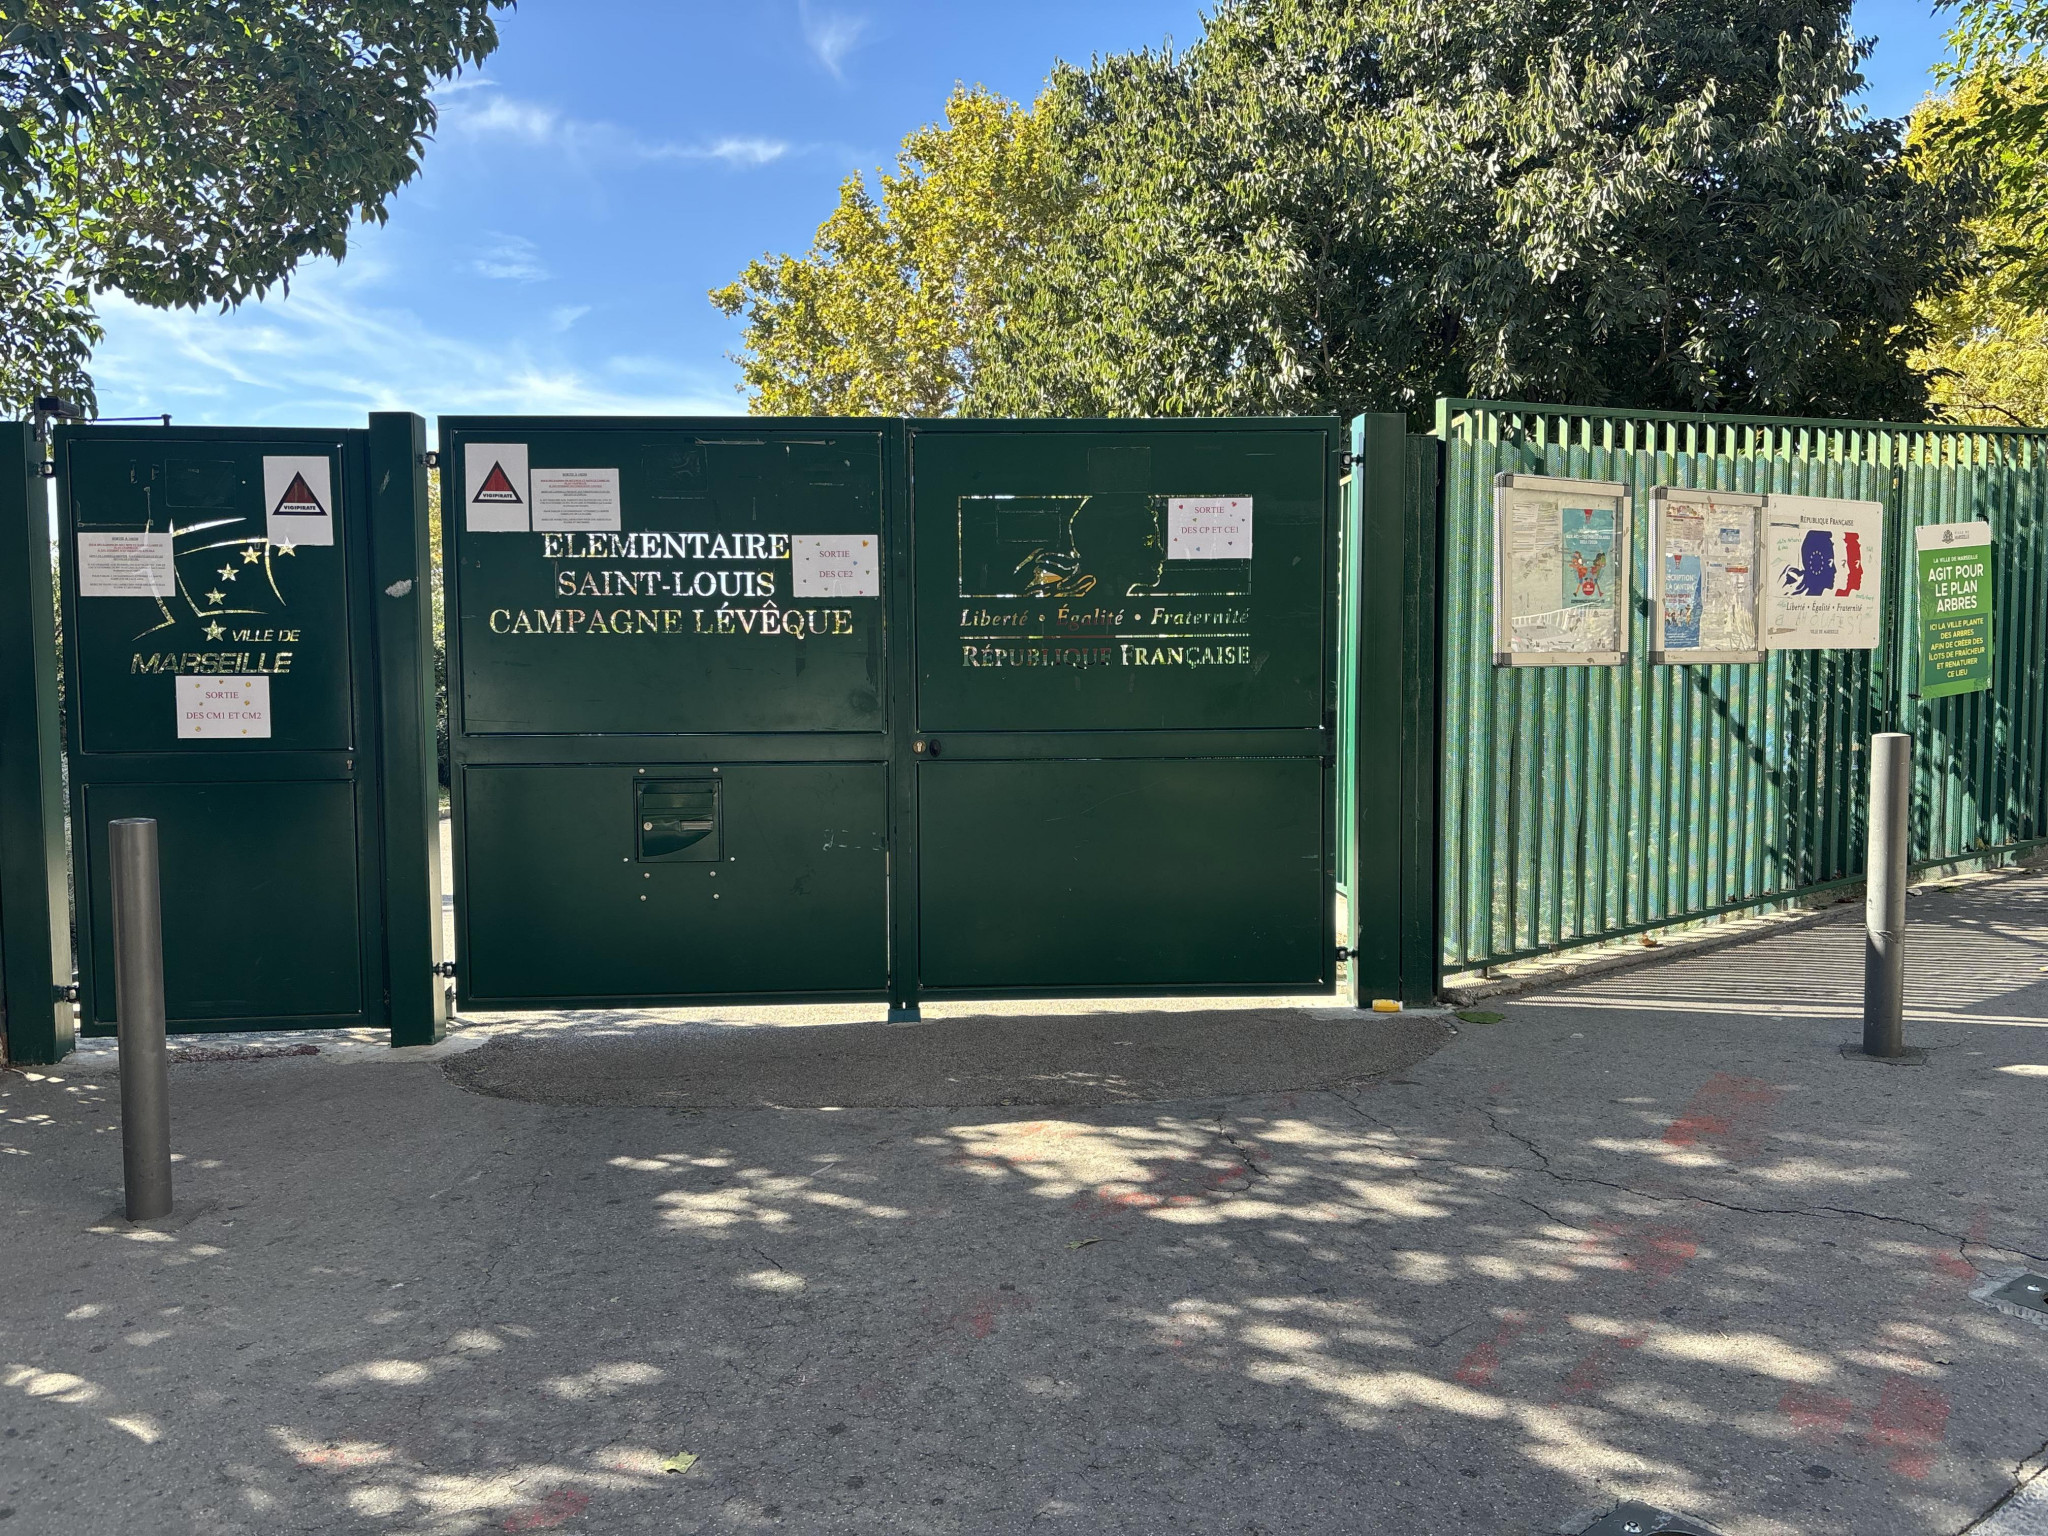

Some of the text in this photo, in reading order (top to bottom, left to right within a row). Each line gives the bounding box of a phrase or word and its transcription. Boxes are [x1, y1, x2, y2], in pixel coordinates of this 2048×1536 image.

[1194, 506, 1225, 514] SORTIE
[1181, 526, 1239, 534] DES CP ET CE1
[541, 532, 790, 559] ELEMENTAIRE
[819, 550, 850, 558] SORTIE
[819, 570, 853, 578] DES CE2
[1928, 563, 1984, 582] AGIT POUR
[558, 570, 776, 597] SAINT-LOUIS
[1935, 579, 1978, 597] LE PLAN
[1786, 602, 1805, 611] Liberté
[1812, 601, 1830, 613] Égalité
[1836, 603, 1862, 612] Fraternité
[1936, 595, 1978, 613] ARBRES
[489, 599, 853, 640] CAMPAGNE LÉVÊQUE
[960, 603, 1251, 631] Liberté Égalité Fraternité
[1938, 622, 1946, 630] LA
[1946, 620, 1962, 628] VILLE
[1962, 617, 1984, 626] PLANTE
[232, 629, 301, 642] VILLE DE
[1940, 628, 1974, 640] DES ARBRES
[1931, 642, 1945, 651] AFIN
[1945, 641, 1953, 649] DE
[1973, 637, 1984, 645] DES
[962, 643, 1251, 670] RÉPUBLIQUE FRANÇAISE
[130, 652, 293, 675] MARSEILLE
[1936, 657, 1978, 670] ET RENATURER
[1947, 668, 1968, 678] CE LIEU
[205, 691, 240, 700] SORTIE
[186, 712, 204, 720] DES
[206, 712, 225, 720] CM1
[242, 712, 262, 720] CM2
